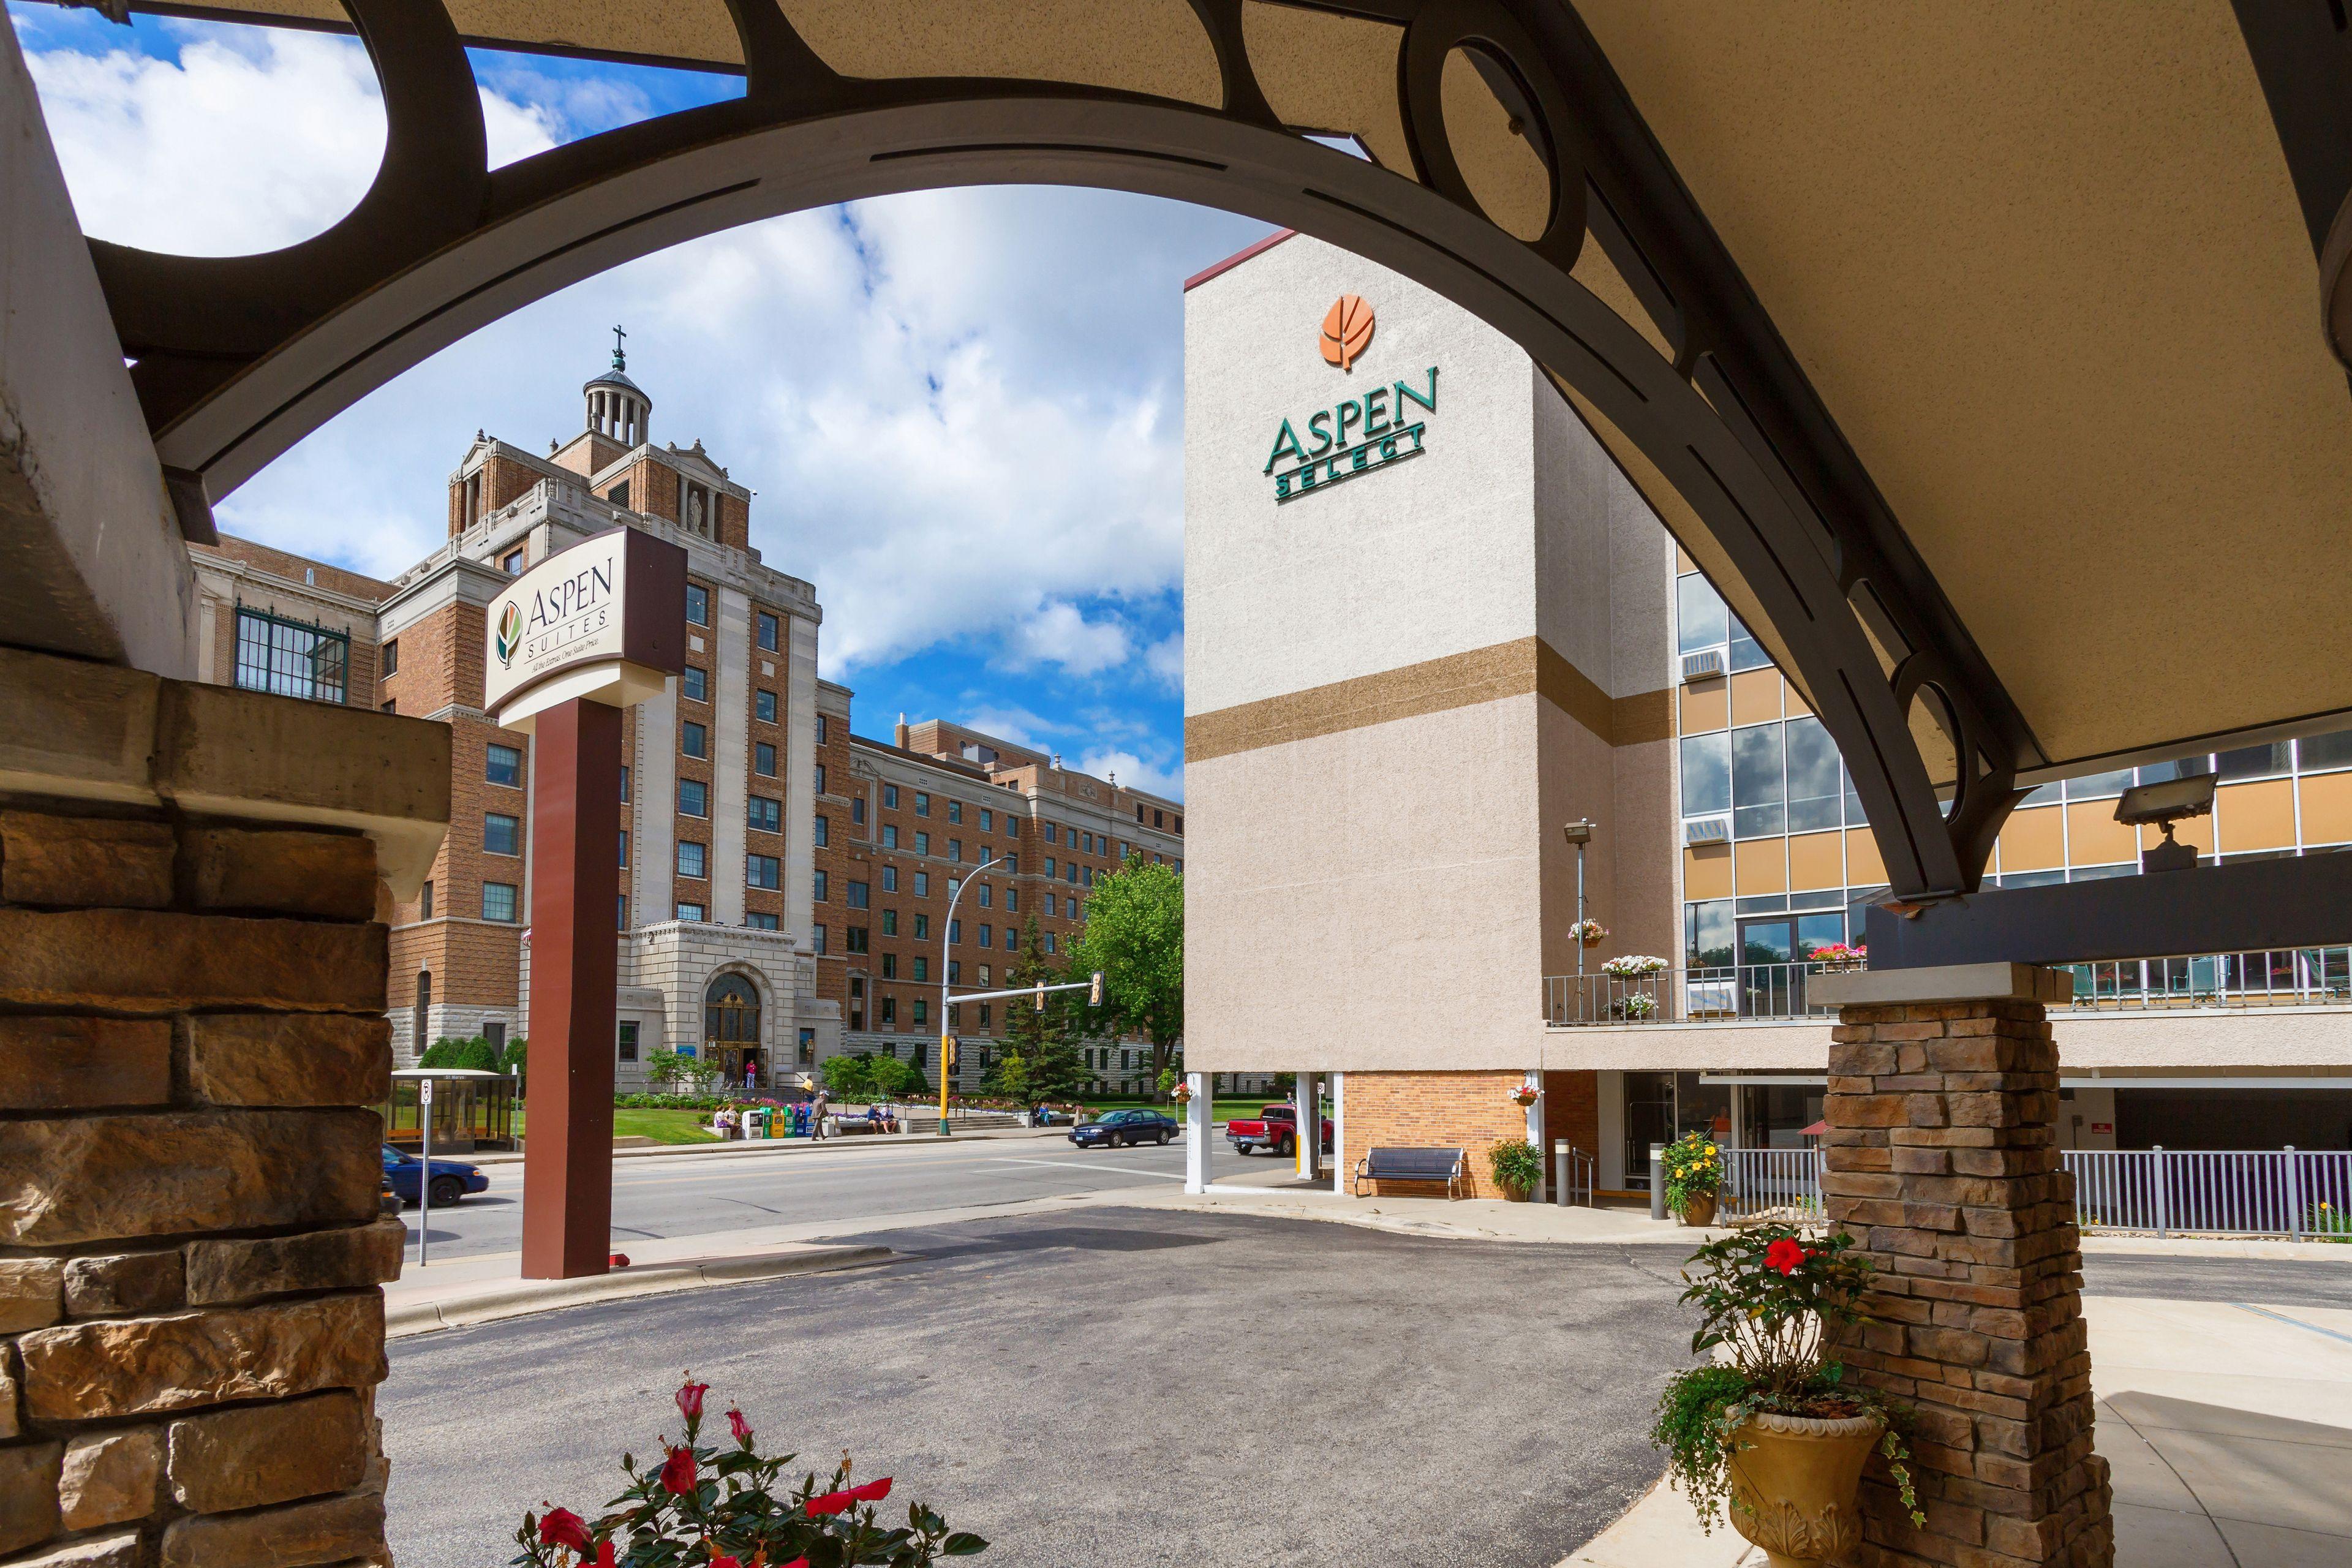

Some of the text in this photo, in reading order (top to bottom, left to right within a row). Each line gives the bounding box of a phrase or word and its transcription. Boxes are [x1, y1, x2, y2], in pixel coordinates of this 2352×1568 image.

[1262, 366, 1438, 473] ASPEN
[1276, 423, 1425, 497] SELECT
[526, 557, 613, 636] ASPEN
[528, 610, 606, 658] SUITES
[562, 649, 573, 660] One
[573, 644, 586, 655] Suite
